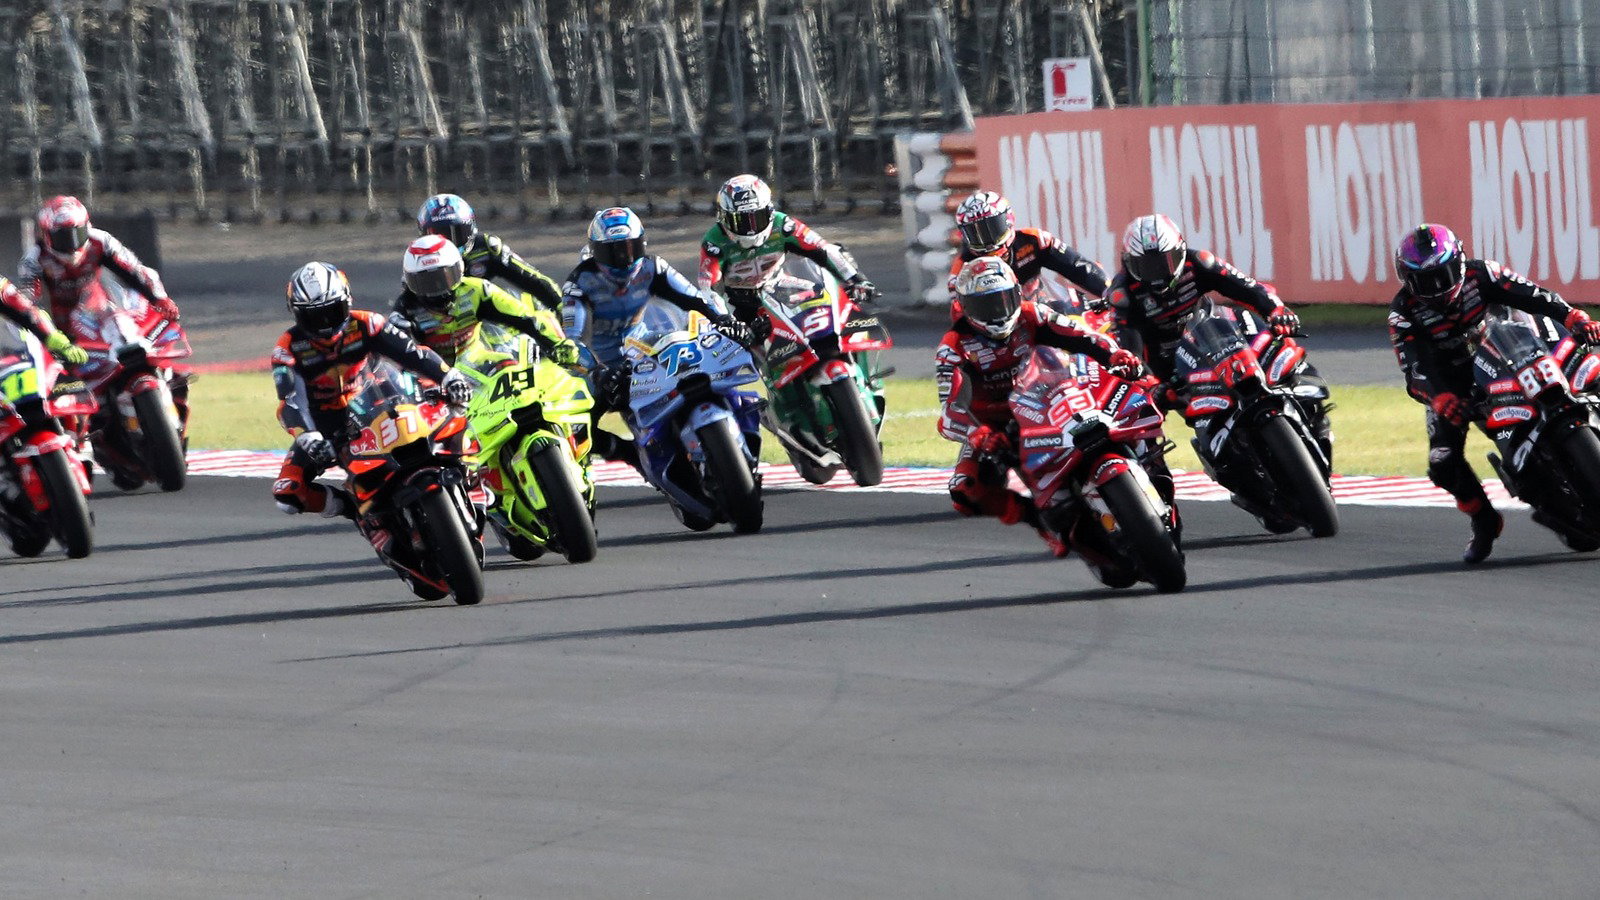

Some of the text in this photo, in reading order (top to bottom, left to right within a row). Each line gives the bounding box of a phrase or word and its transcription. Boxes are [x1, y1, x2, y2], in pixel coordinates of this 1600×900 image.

[998, 130, 1116, 282] MOTUL
[1149, 122, 1273, 282] MOTUL
[1305, 121, 1426, 284] MOTUL
[1468, 116, 1600, 285] MOTUL
[658, 341, 704, 378] 73
[490, 367, 535, 404] 49
[1103, 383, 1129, 416] Lenovo
[1048, 388, 1096, 428] 93
[1024, 437, 1062, 448] Lenovo
[1496, 429, 1514, 440] sky
